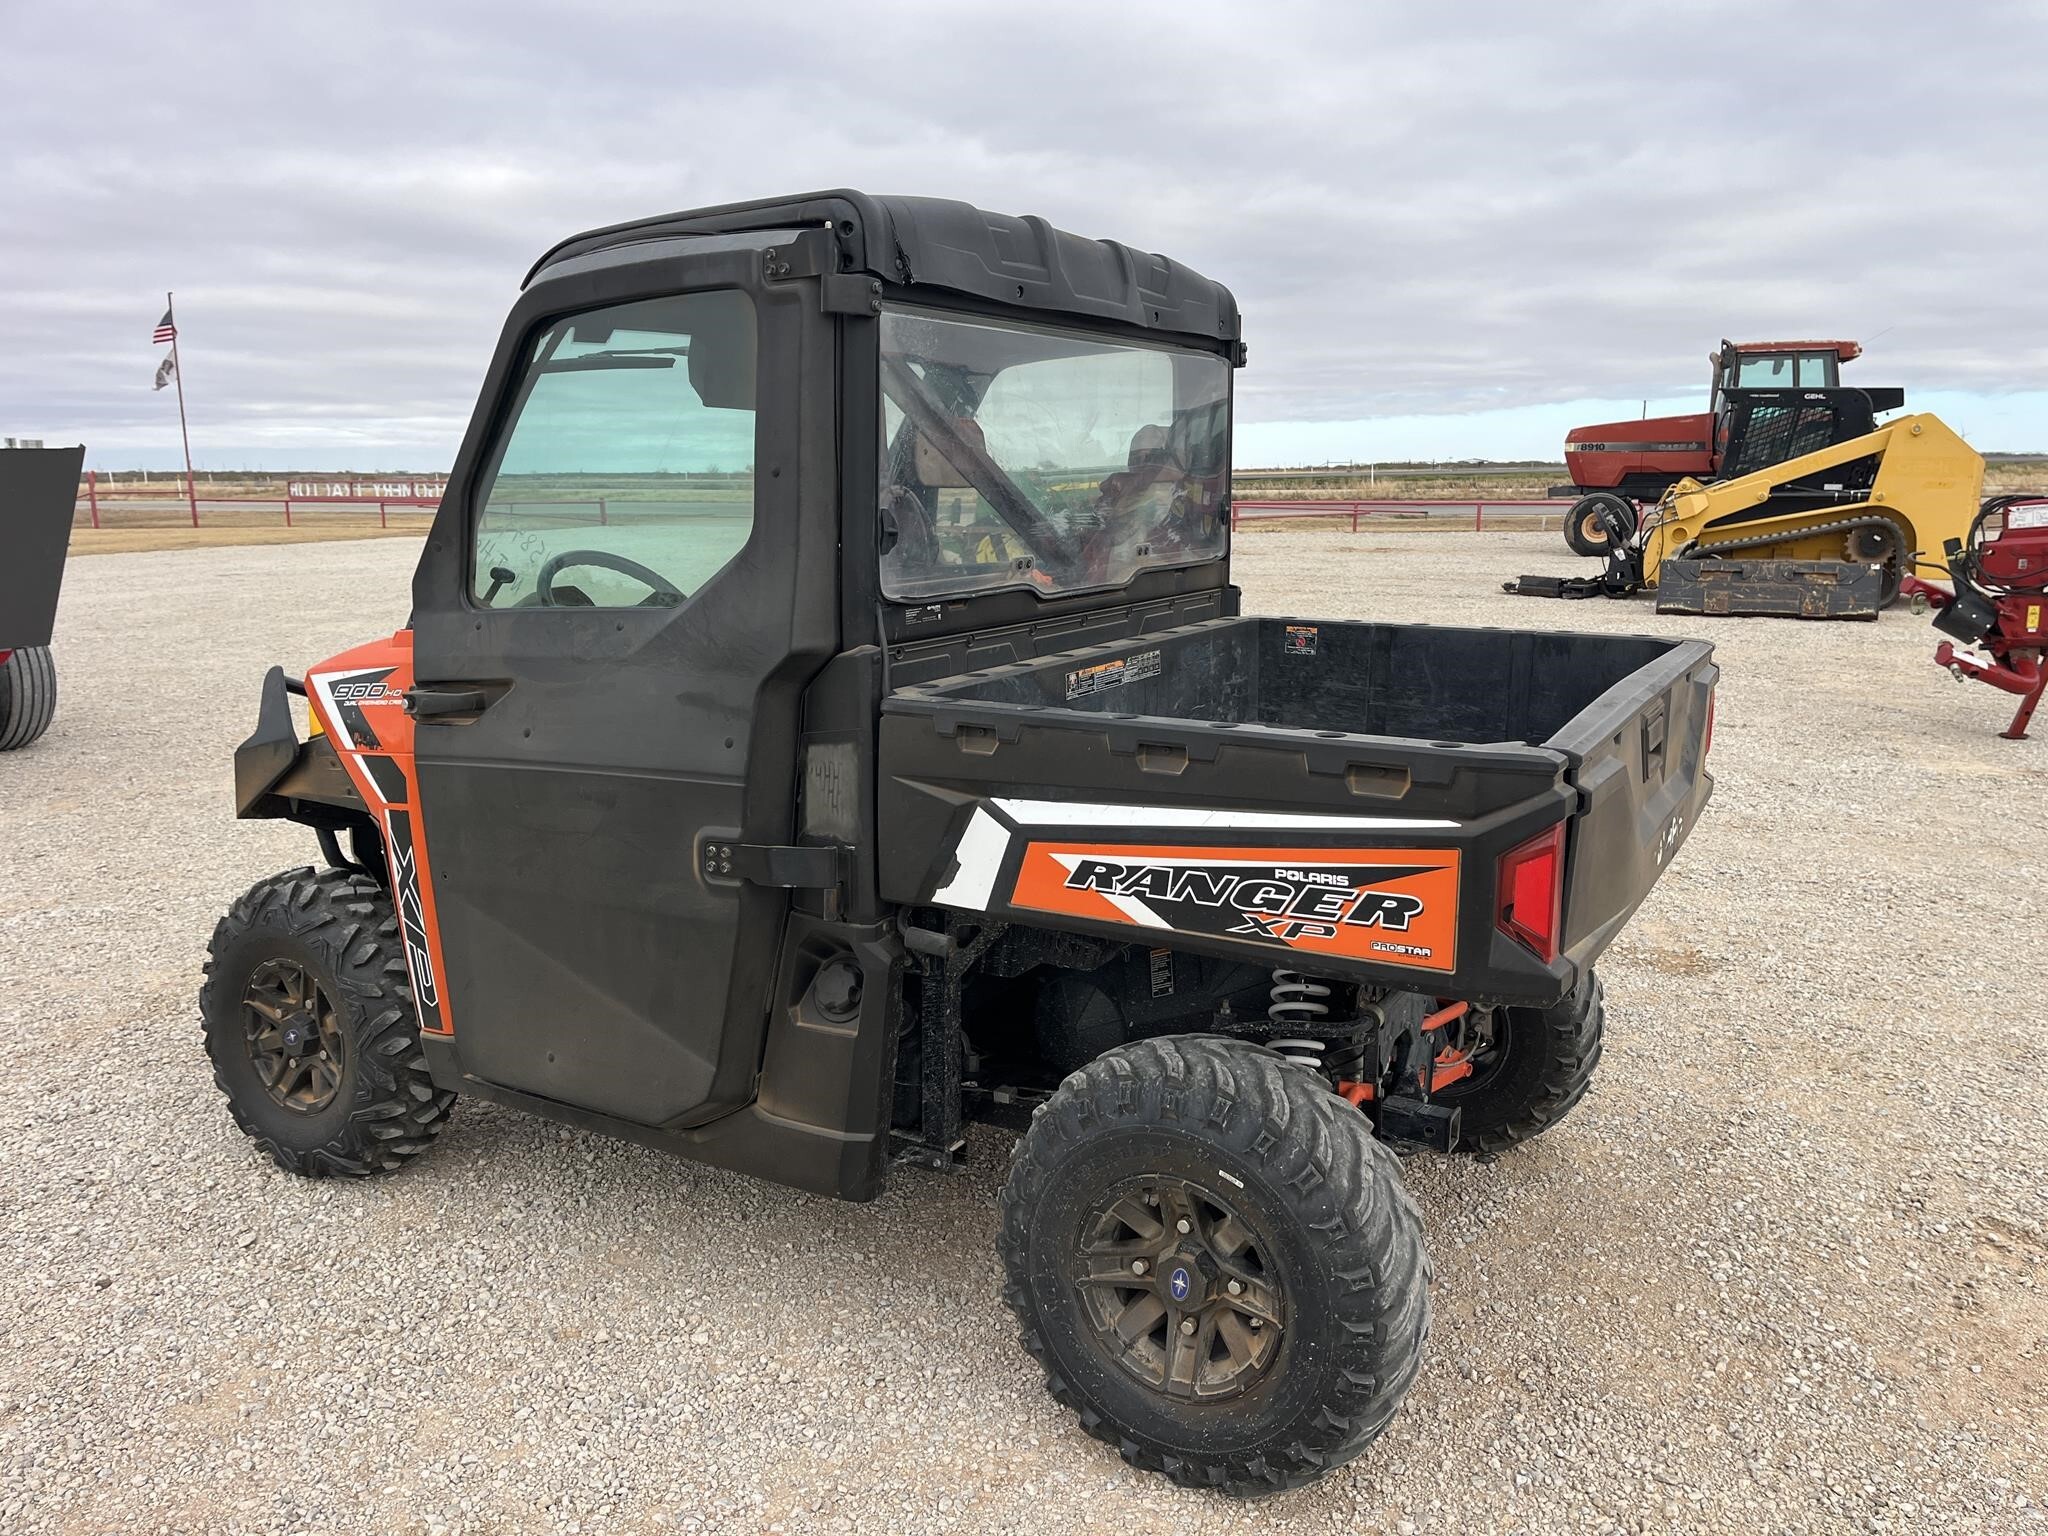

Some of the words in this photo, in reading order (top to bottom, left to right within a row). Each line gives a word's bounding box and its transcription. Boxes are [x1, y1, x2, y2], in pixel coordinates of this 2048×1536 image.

[1580, 442, 1606, 451] 8910
[332, 682, 388, 700] 900
[1274, 868, 1349, 887] POLARIS
[1064, 859, 1424, 931] RANGER
[390, 831, 438, 1007] XP
[1225, 913, 1337, 940] XP
[1371, 941, 1432, 957] PROSTAR
